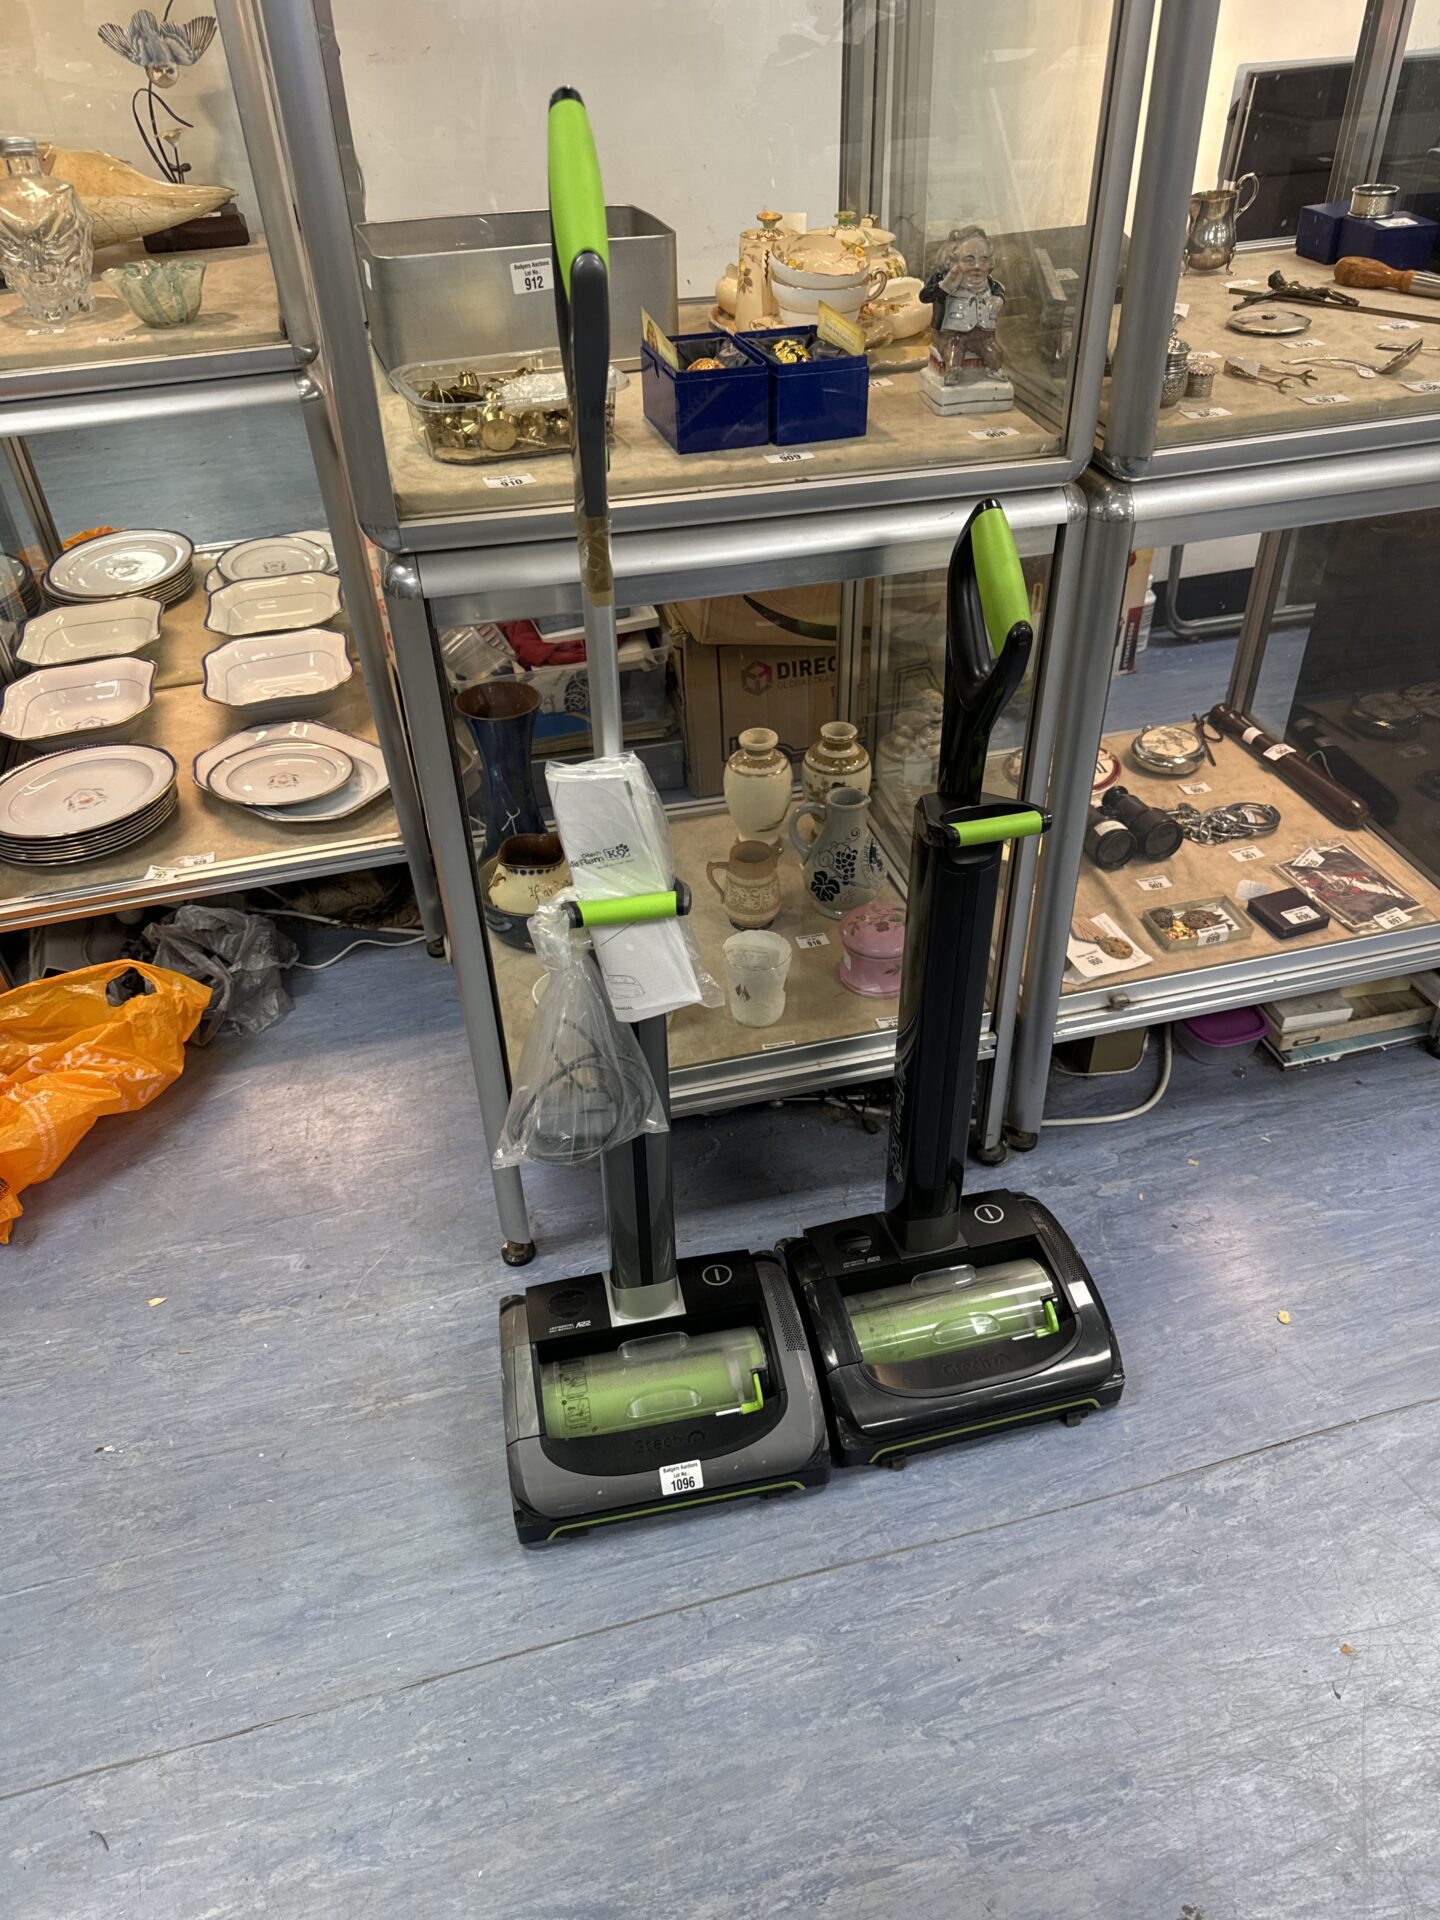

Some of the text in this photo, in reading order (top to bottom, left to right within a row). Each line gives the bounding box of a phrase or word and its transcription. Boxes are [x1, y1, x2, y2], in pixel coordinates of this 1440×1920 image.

[524, 275, 544, 291] 912
[500, 479, 523, 487] 910
[671, 1476, 696, 1492] 1096
